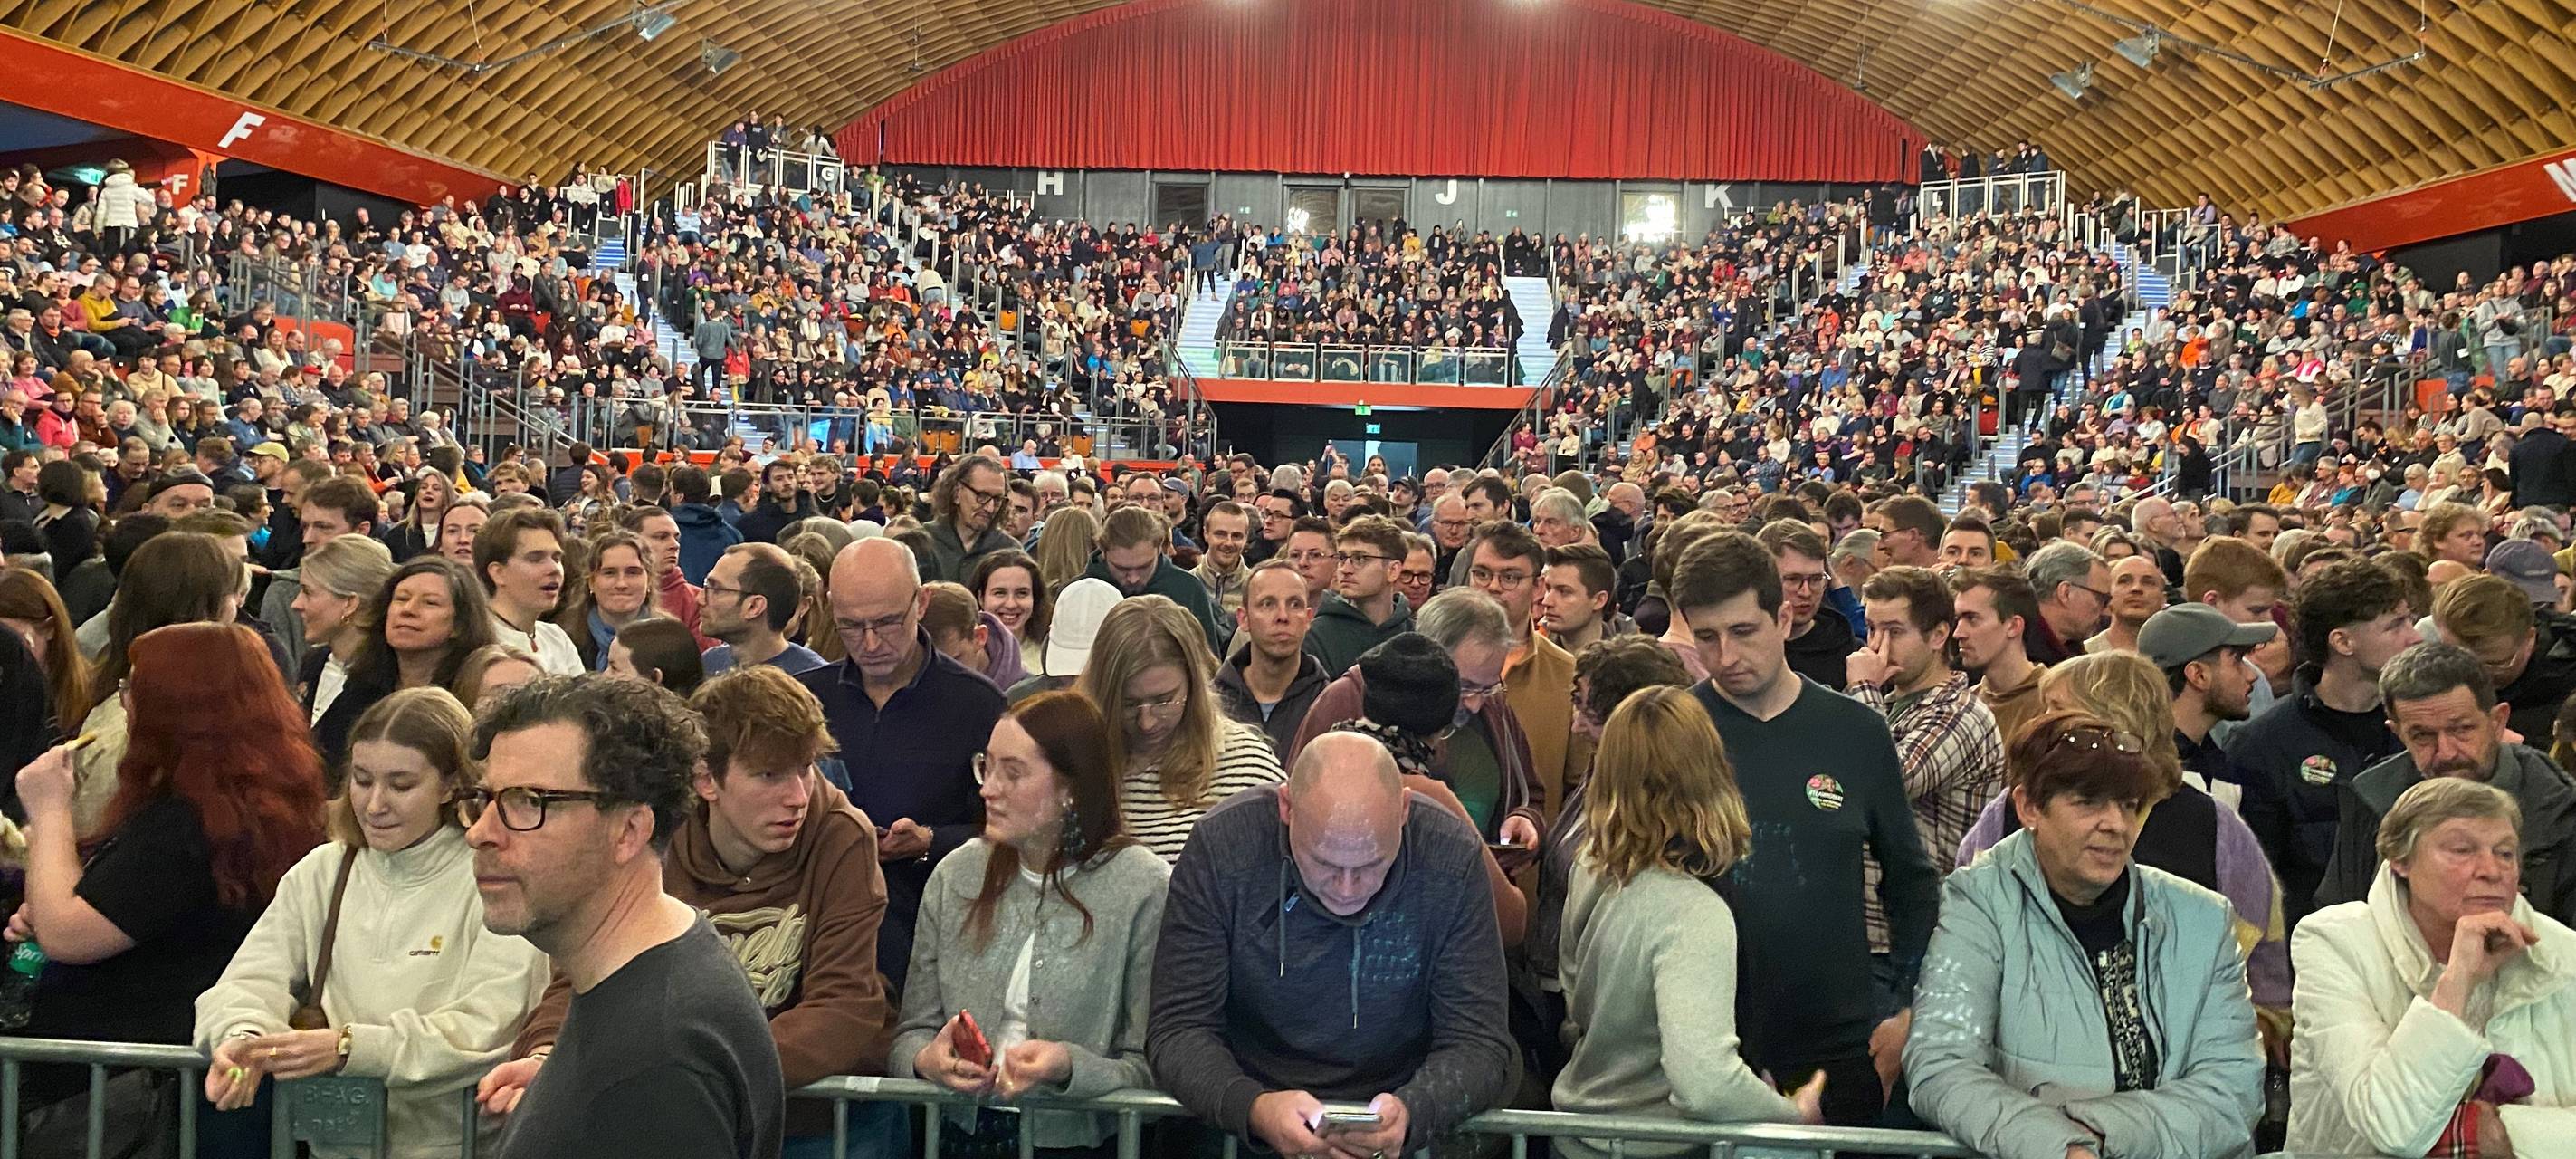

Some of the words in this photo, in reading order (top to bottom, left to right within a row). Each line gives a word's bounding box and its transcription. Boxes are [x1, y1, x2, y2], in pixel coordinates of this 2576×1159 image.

[216, 110, 266, 148] F
[172, 174, 188, 195] F
[822, 167, 835, 181] G
[1037, 171, 1063, 195] H
[1435, 179, 1457, 205] J
[1705, 184, 1733, 208] K
[1932, 192, 1943, 206] L
[1728, 216, 1743, 229] K
